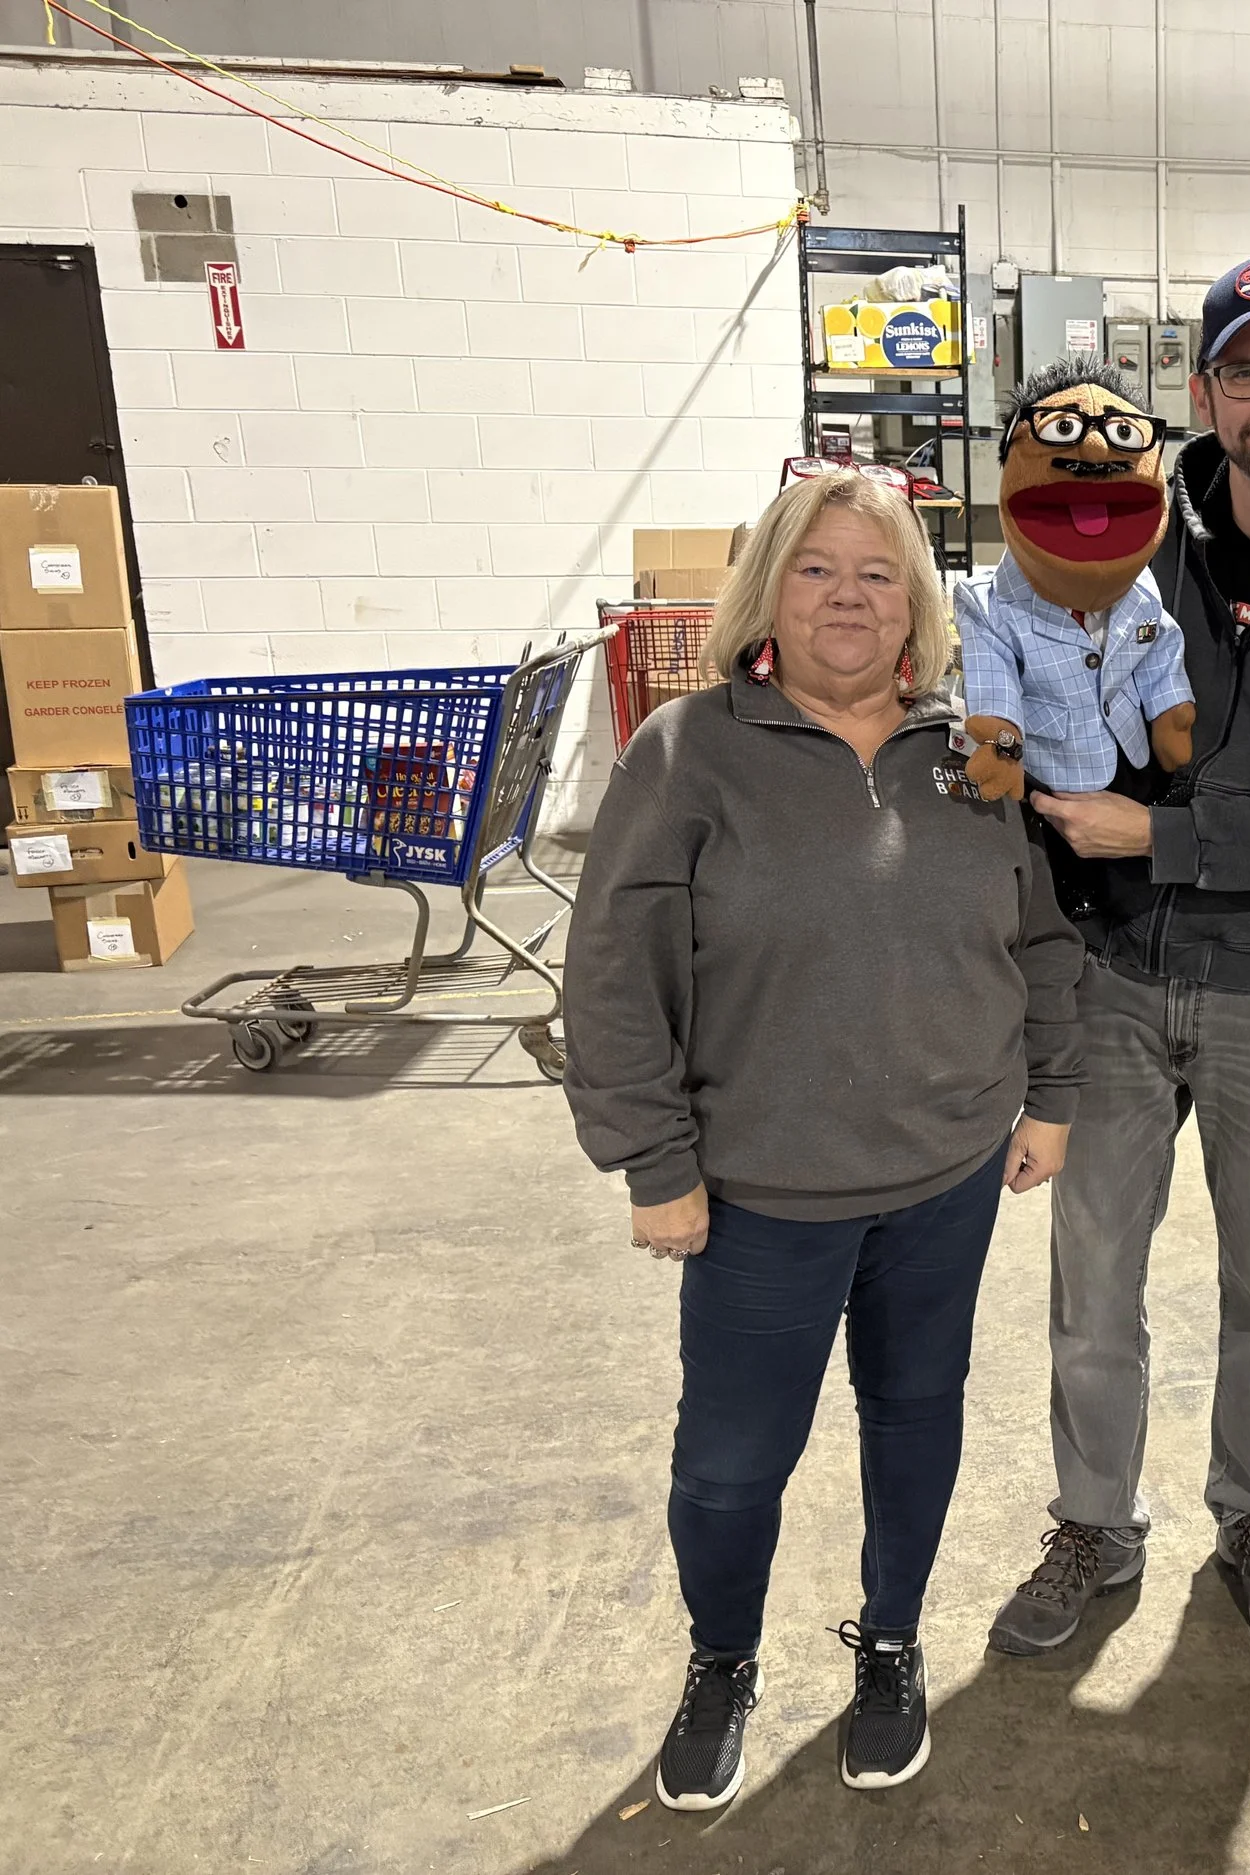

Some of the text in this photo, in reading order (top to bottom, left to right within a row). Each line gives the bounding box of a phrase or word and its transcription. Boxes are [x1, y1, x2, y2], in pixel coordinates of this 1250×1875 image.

[211, 273, 233, 284] FIRE
[220, 285, 233, 340] EXTINGUISHER
[885, 322, 938, 338] Sunkist
[895, 341, 930, 351] LEMONS
[26, 679, 111, 689] KEEP FROZEN
[24, 706, 70, 717] GARDER
[932, 766, 977, 785] CHE
[405, 846, 446, 862] JYSK
